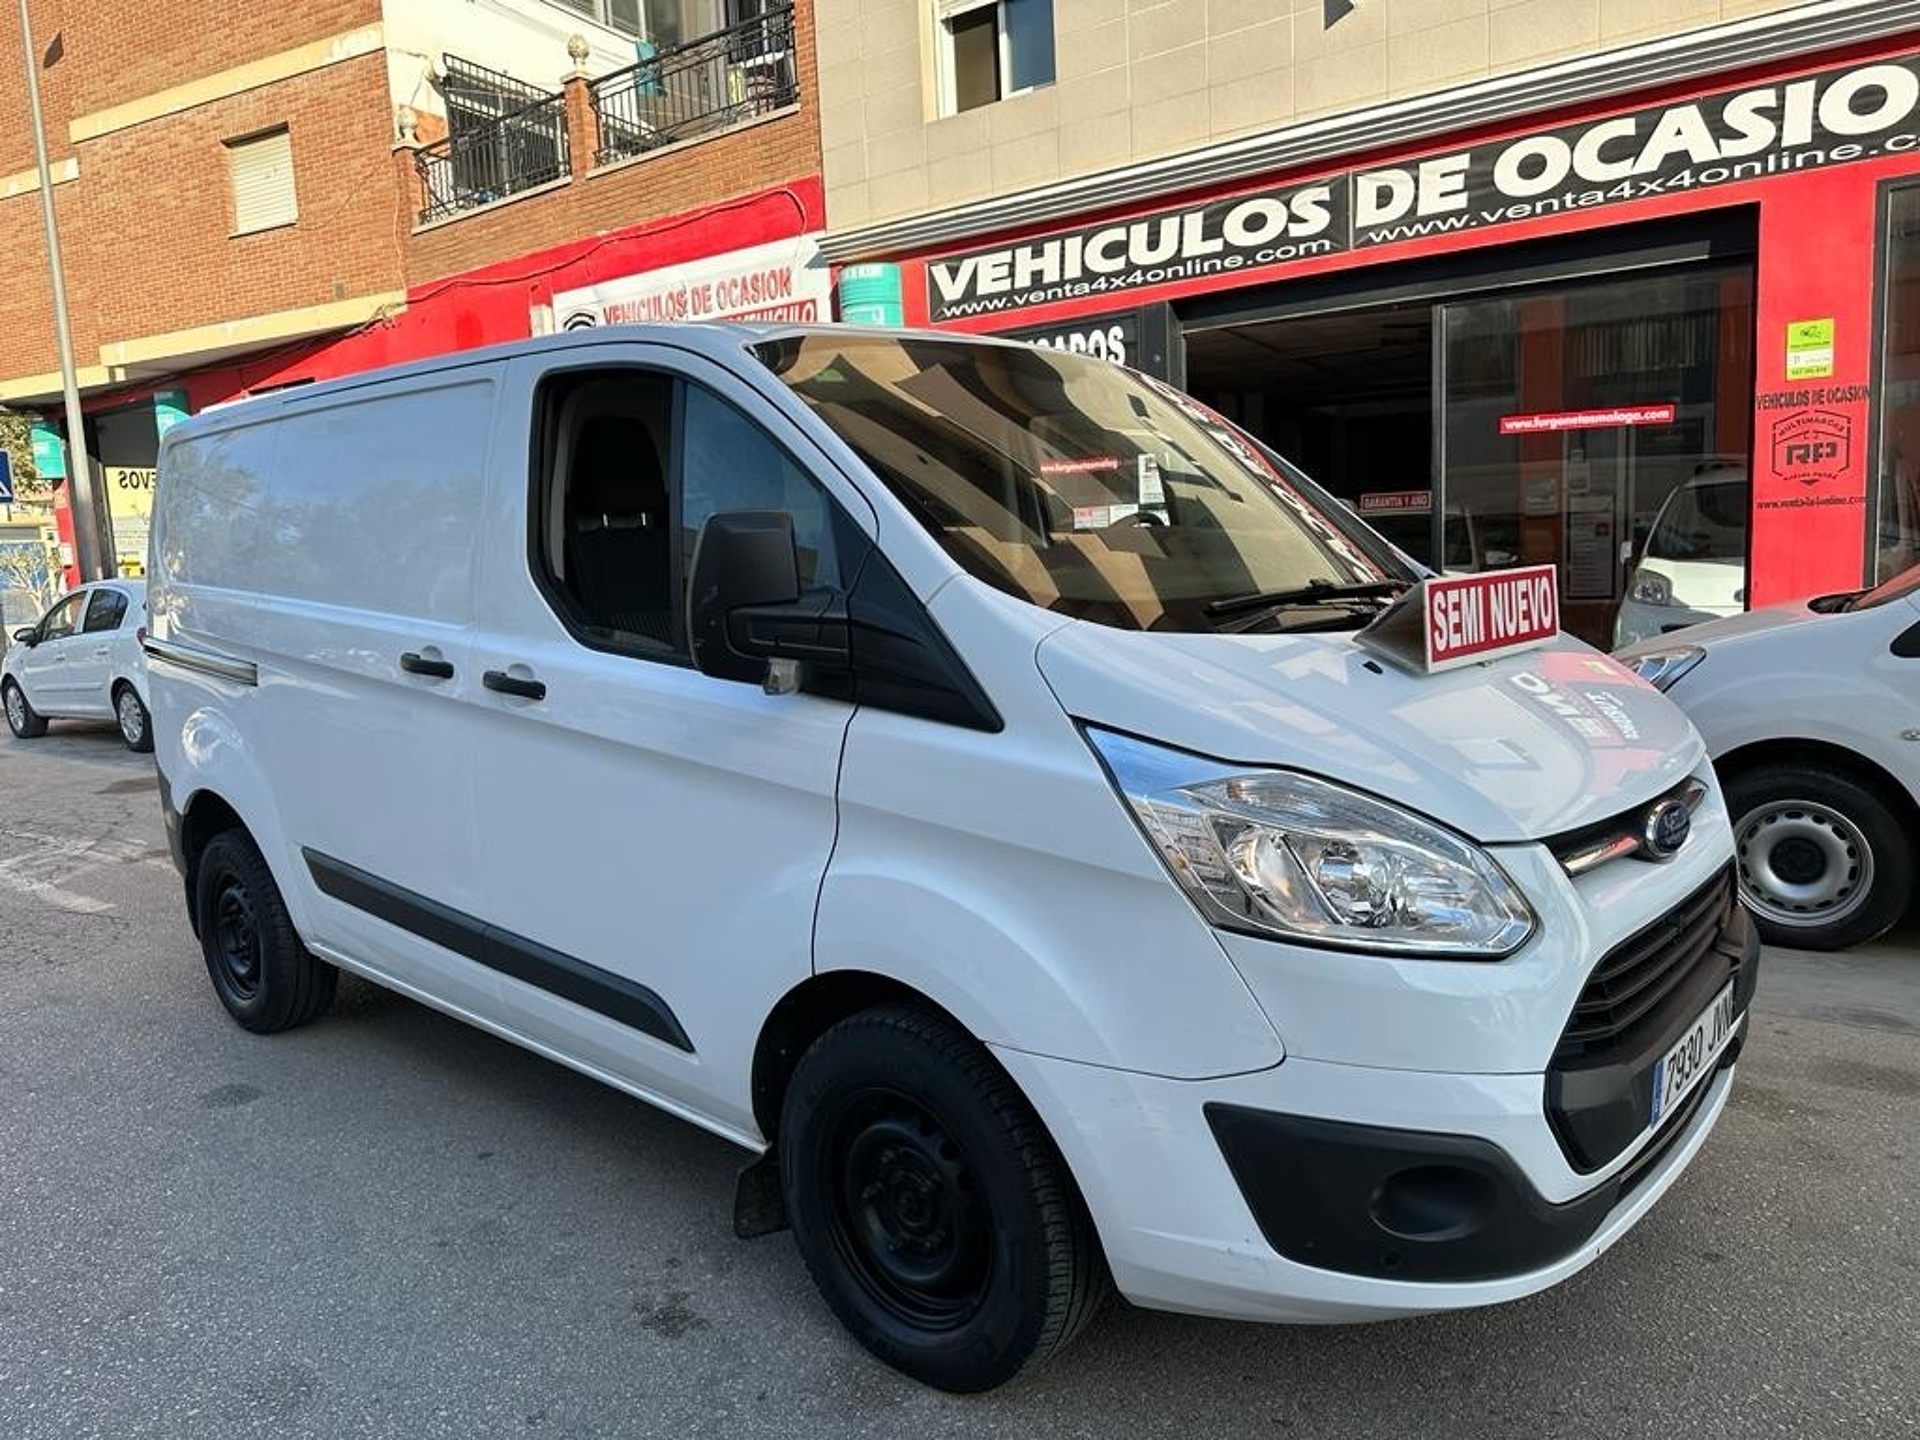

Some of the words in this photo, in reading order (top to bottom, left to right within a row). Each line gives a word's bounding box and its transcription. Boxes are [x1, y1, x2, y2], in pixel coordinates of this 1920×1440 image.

[929, 186, 1330, 301] VEHICULOS
[1355, 153, 1471, 228] DE
[1493, 65, 1919, 199] OCASIO
[1369, 134, 1920, 243] www.venta4x4online.c
[603, 288, 687, 325] VEHICULOS
[690, 283, 712, 314] DE
[716, 267, 792, 311] OCASION
[943, 239, 1330, 318] www.venta4x4online.com
[1756, 389, 1810, 410] VEHICULOS
[1811, 388, 1825, 405] DE
[1433, 586, 1485, 652] SEMI
[1490, 576, 1553, 640] NUEVO
[1665, 1025, 1703, 1106] 7930
